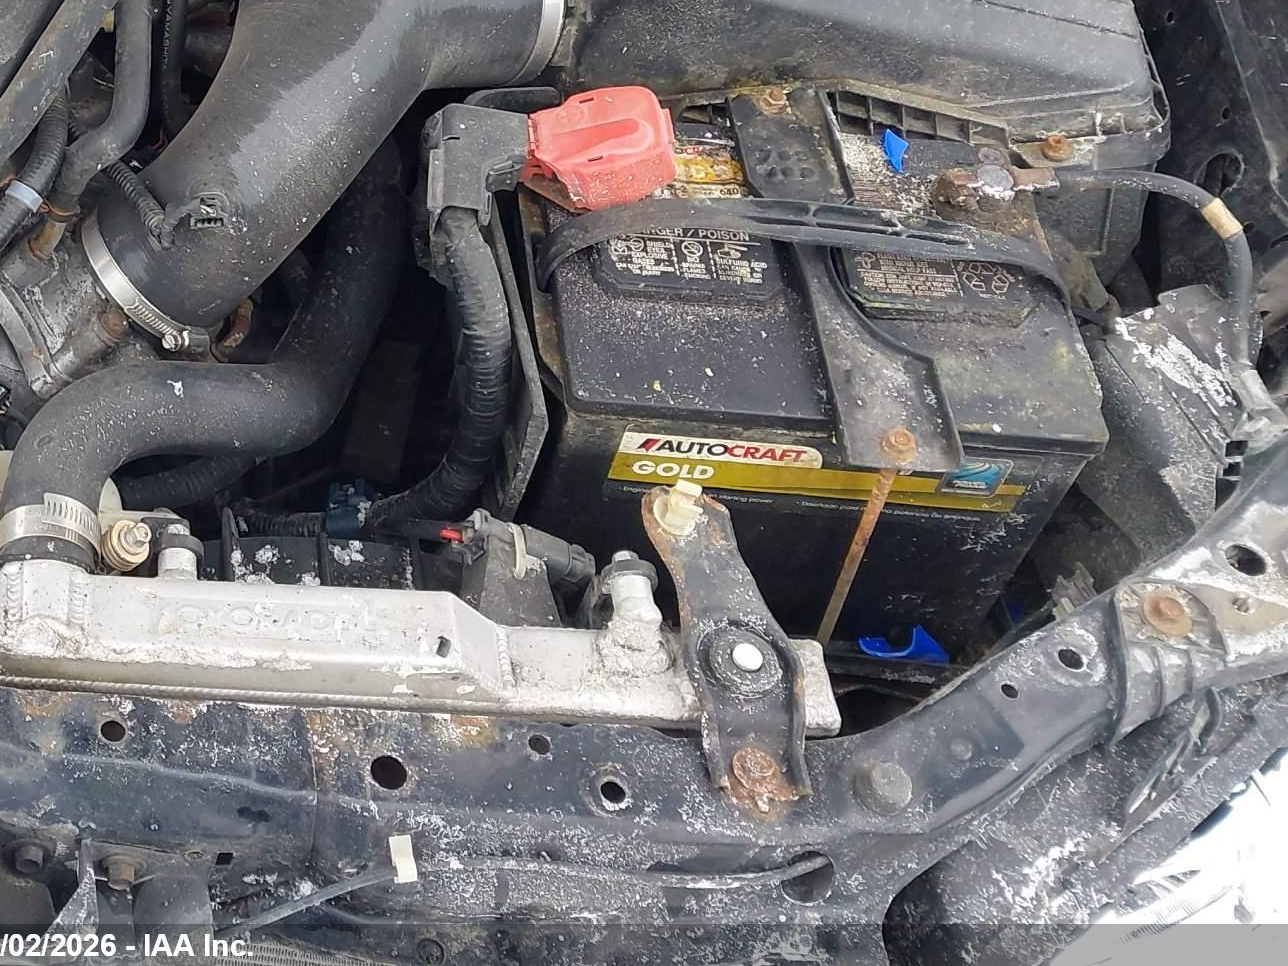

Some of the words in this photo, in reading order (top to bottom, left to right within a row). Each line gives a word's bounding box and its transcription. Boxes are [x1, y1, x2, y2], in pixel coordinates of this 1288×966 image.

[698, 229, 750, 242] POISON
[660, 439, 808, 463] AUTOCRAFT
[632, 460, 715, 479] GOLD
